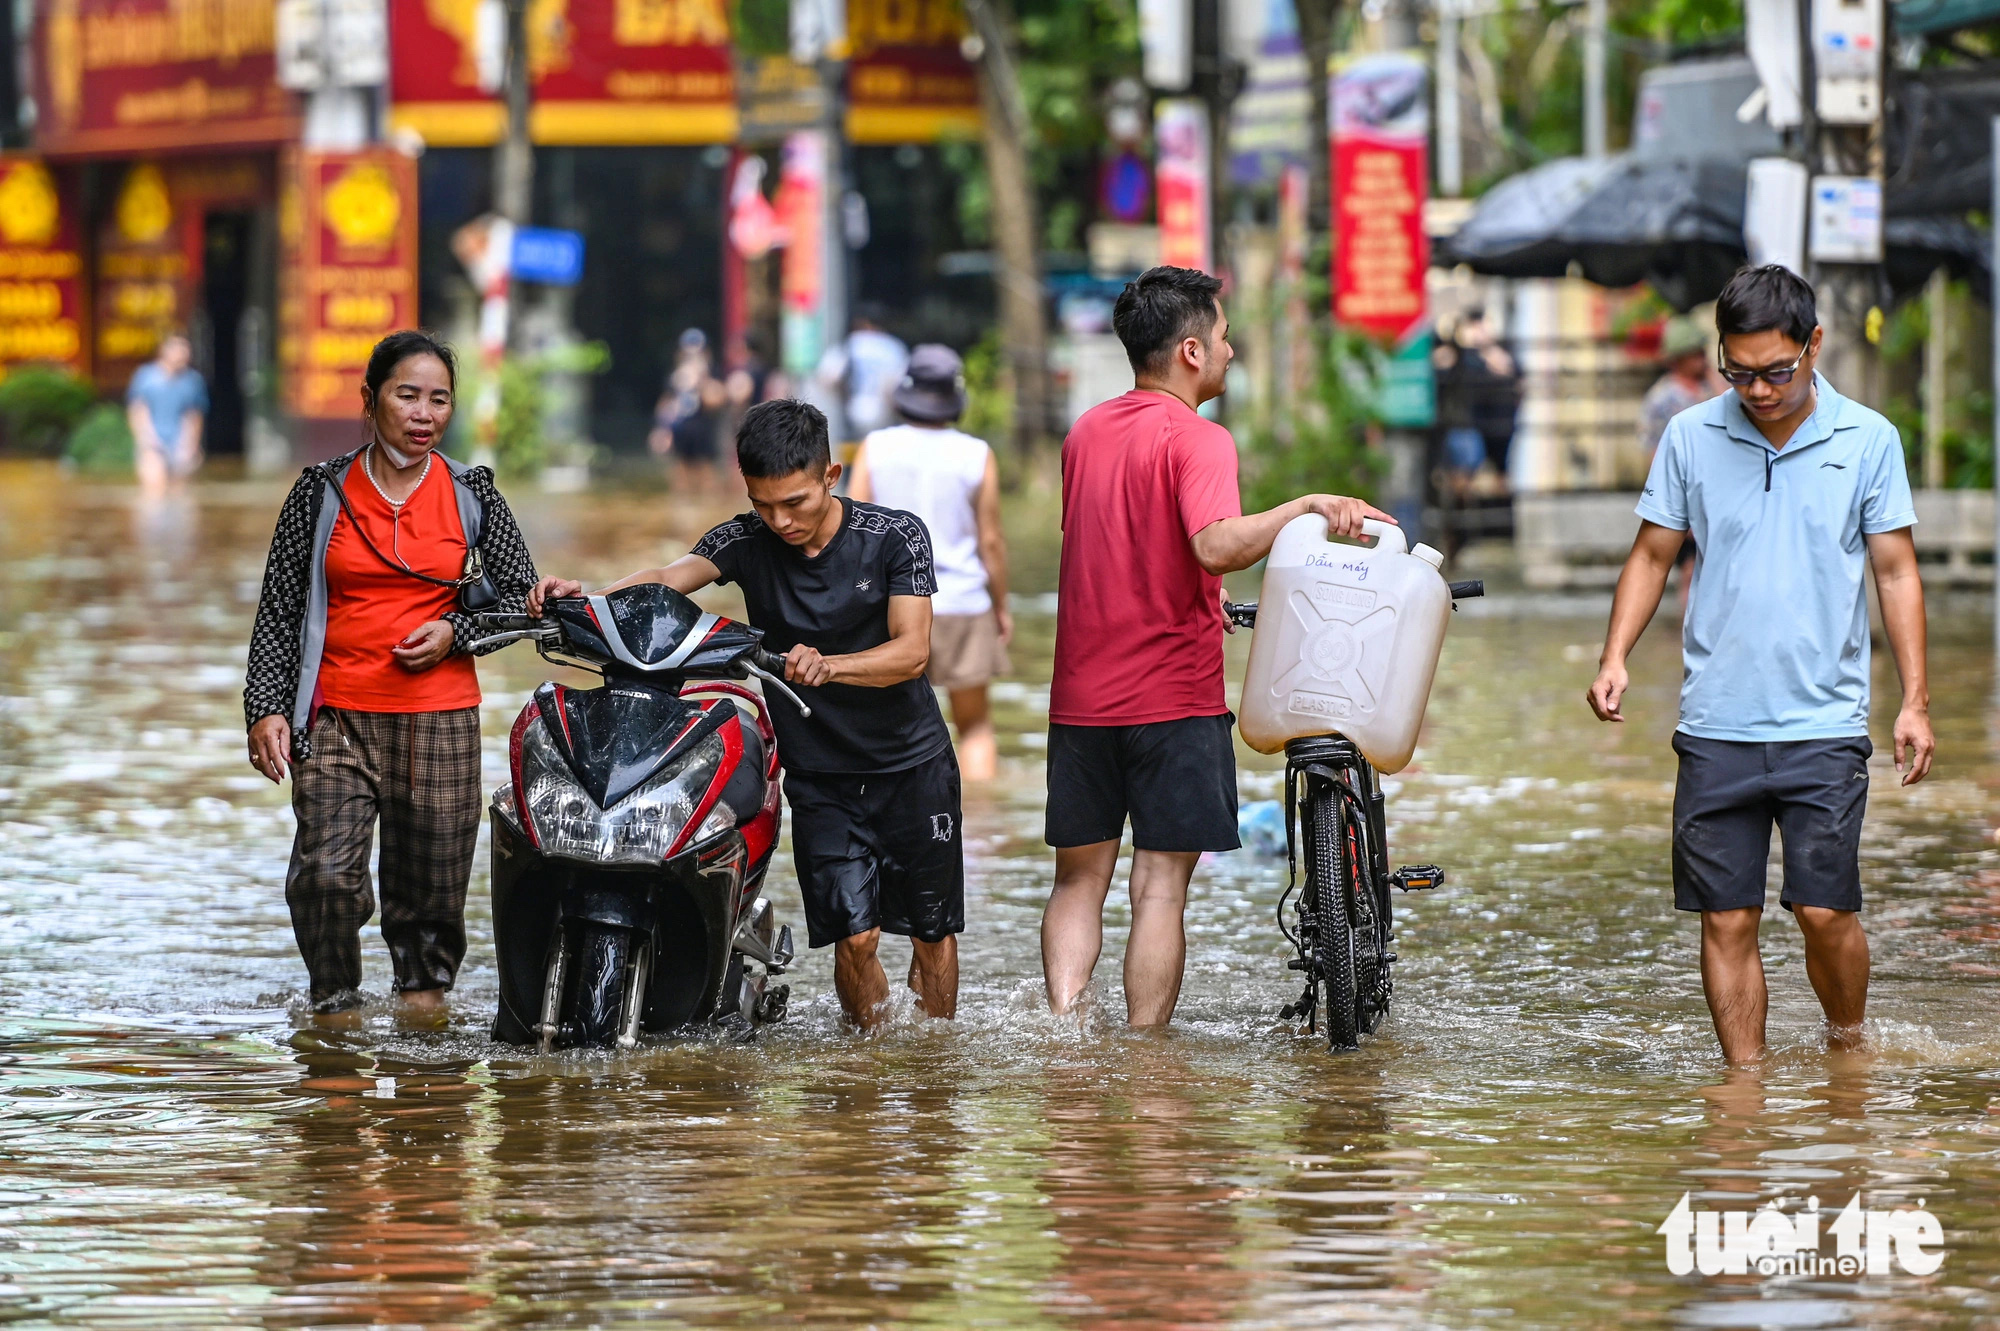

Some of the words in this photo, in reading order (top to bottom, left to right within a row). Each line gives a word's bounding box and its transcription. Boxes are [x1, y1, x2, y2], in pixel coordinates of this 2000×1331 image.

[1315, 586, 1344, 604] SONG
[1345, 590, 1373, 609] LONG
[1317, 640, 1345, 661] 30
[610, 689, 652, 700] HONDA
[1293, 695, 1347, 716] PLASTIC
